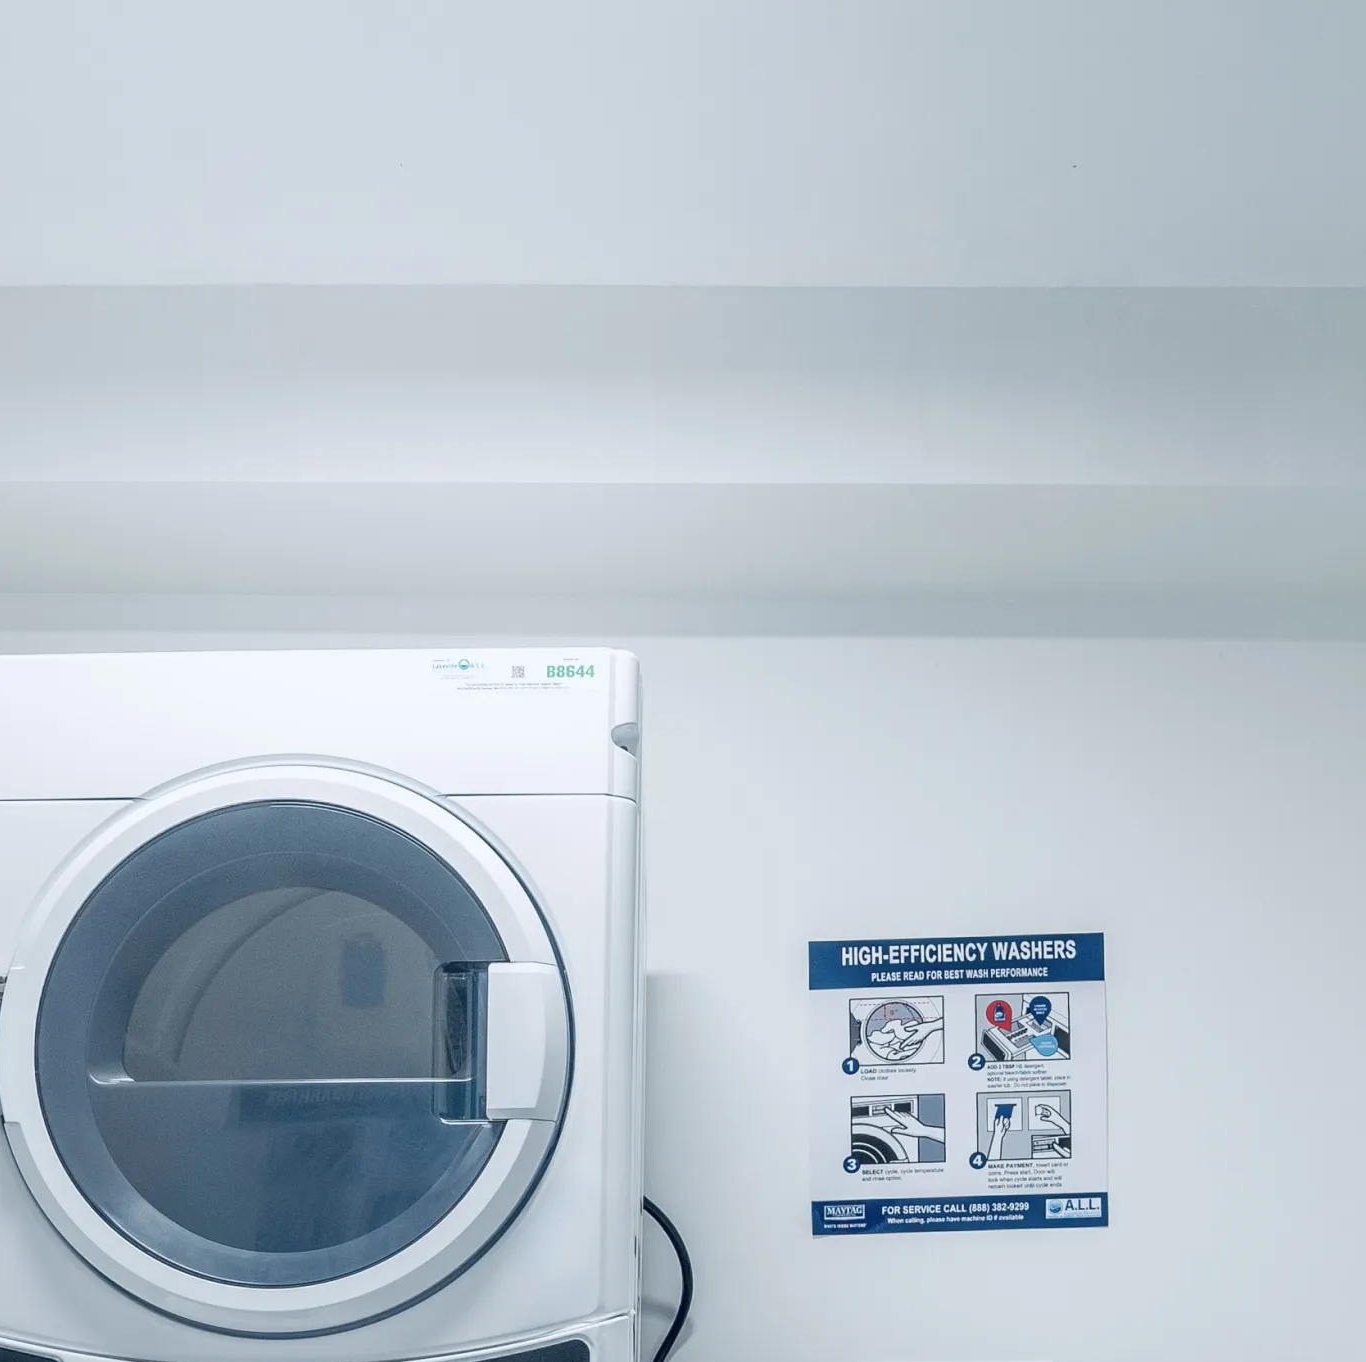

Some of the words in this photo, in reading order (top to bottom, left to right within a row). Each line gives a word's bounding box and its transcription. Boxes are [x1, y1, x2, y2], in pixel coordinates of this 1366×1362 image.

[547, 664, 595, 678] B8644
[841, 942, 988, 966] HIGH-EFFICIENCY
[992, 940, 1077, 961] WASHERS
[871, 972, 902, 982] PLEASE
[903, 971, 925, 980] READ
[926, 970, 943, 980] FOR
[944, 969, 964, 979] BEST
[966, 968, 989, 978] WASH
[990, 967, 1049, 978] PERFORMANCE
[846, 1060, 854, 1072] 1
[971, 1056, 982, 1068] 2
[846, 1158, 857, 1171] 3
[972, 1154, 983, 1167] 4
[826, 1206, 863, 1215] MAYTAG
[881, 1206, 901, 1215] FOR
[902, 1204, 942, 1214] SERVICE
[943, 1203, 967, 1213] CALL
[968, 1203, 990, 1214] (888)
[991, 1202, 1029, 1212] 382-9299
[1065, 1198, 1100, 1211] A.L.L.
[905, 1216, 926, 1225] calling,
[926, 1216, 945, 1224] please
